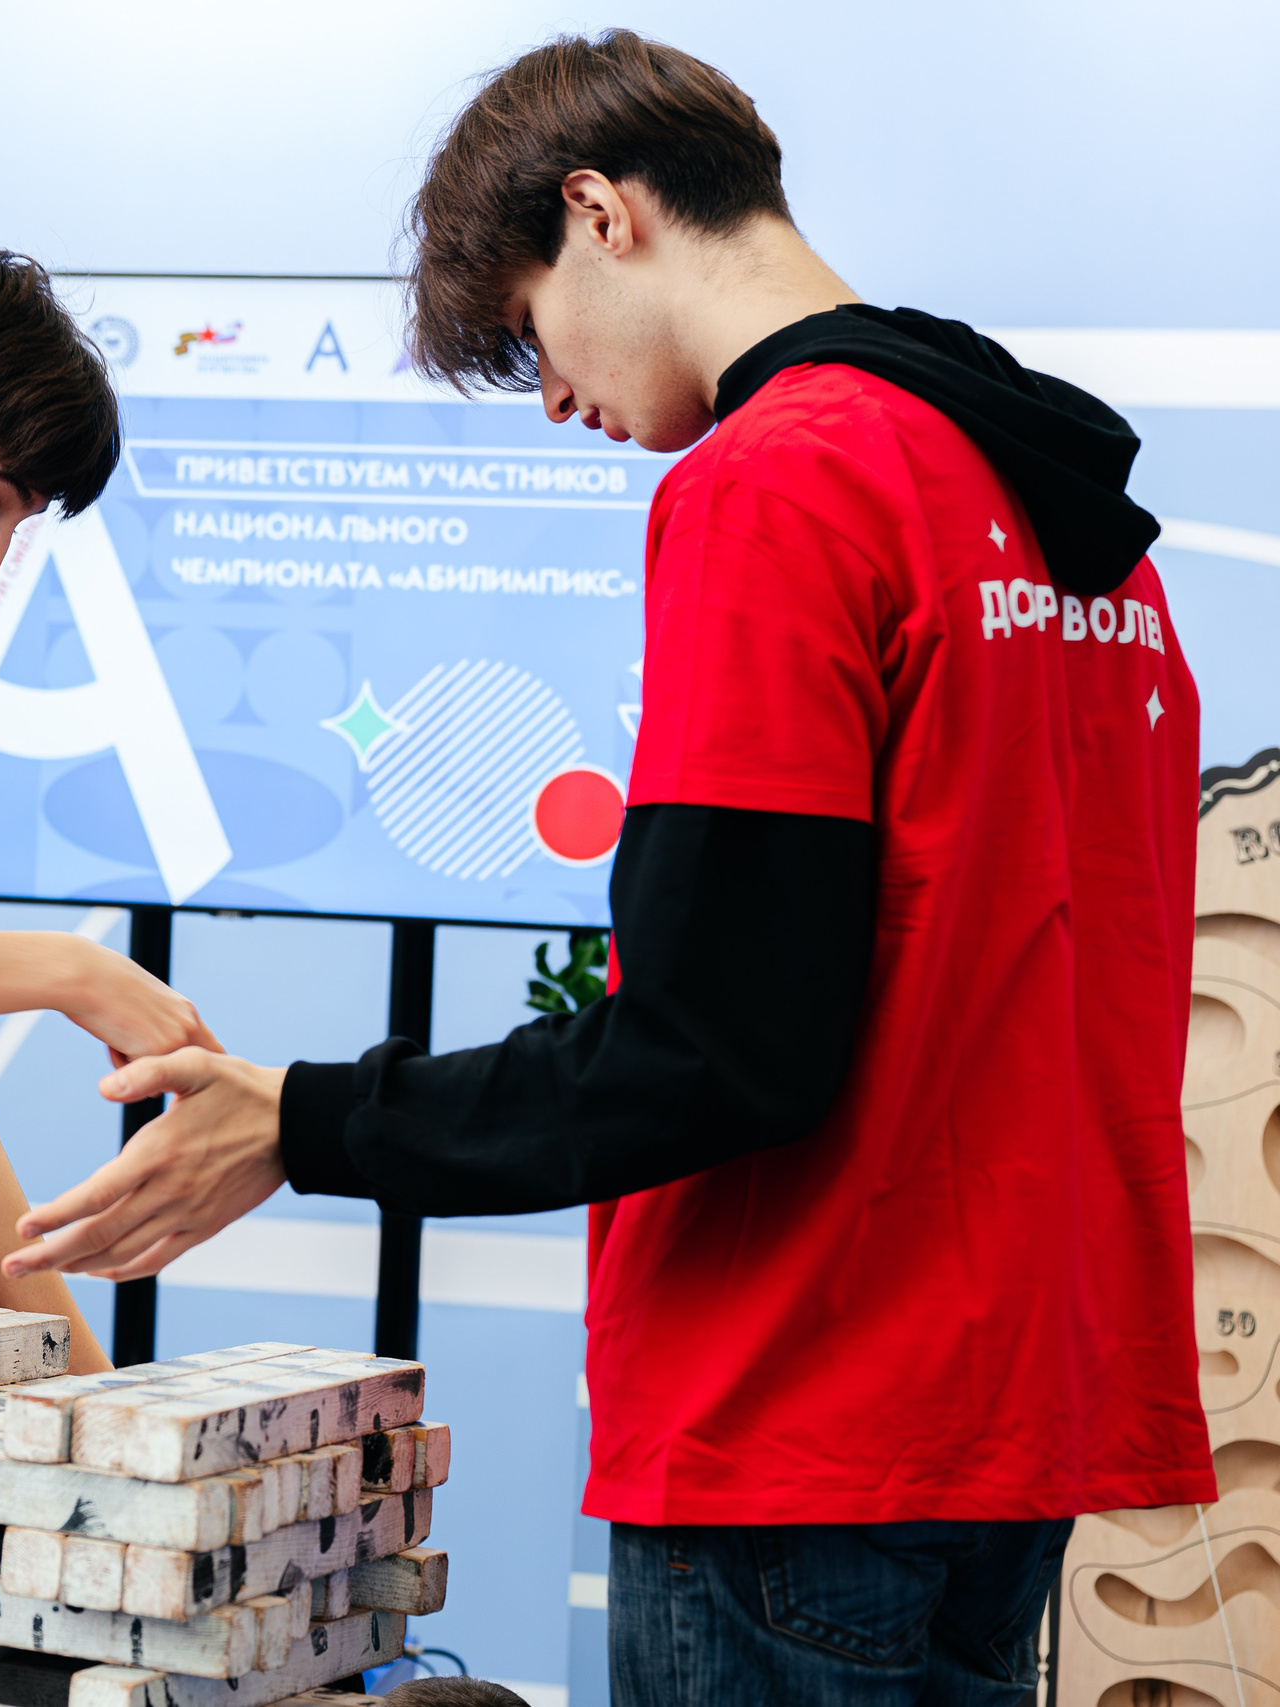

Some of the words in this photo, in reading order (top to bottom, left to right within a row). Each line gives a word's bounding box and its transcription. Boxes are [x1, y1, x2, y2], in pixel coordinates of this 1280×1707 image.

[175, 455, 410, 489] ПРИВЕТСТВУЕМ
[415, 461, 628, 494] УЧАСТНИКОВ
[173, 510, 469, 547] НАЦИОНАЛЬНОГО
[171, 556, 383, 590] ЧЕМПИОНАТА
[388, 563, 637, 598] «АБИЛИМПИКС»
